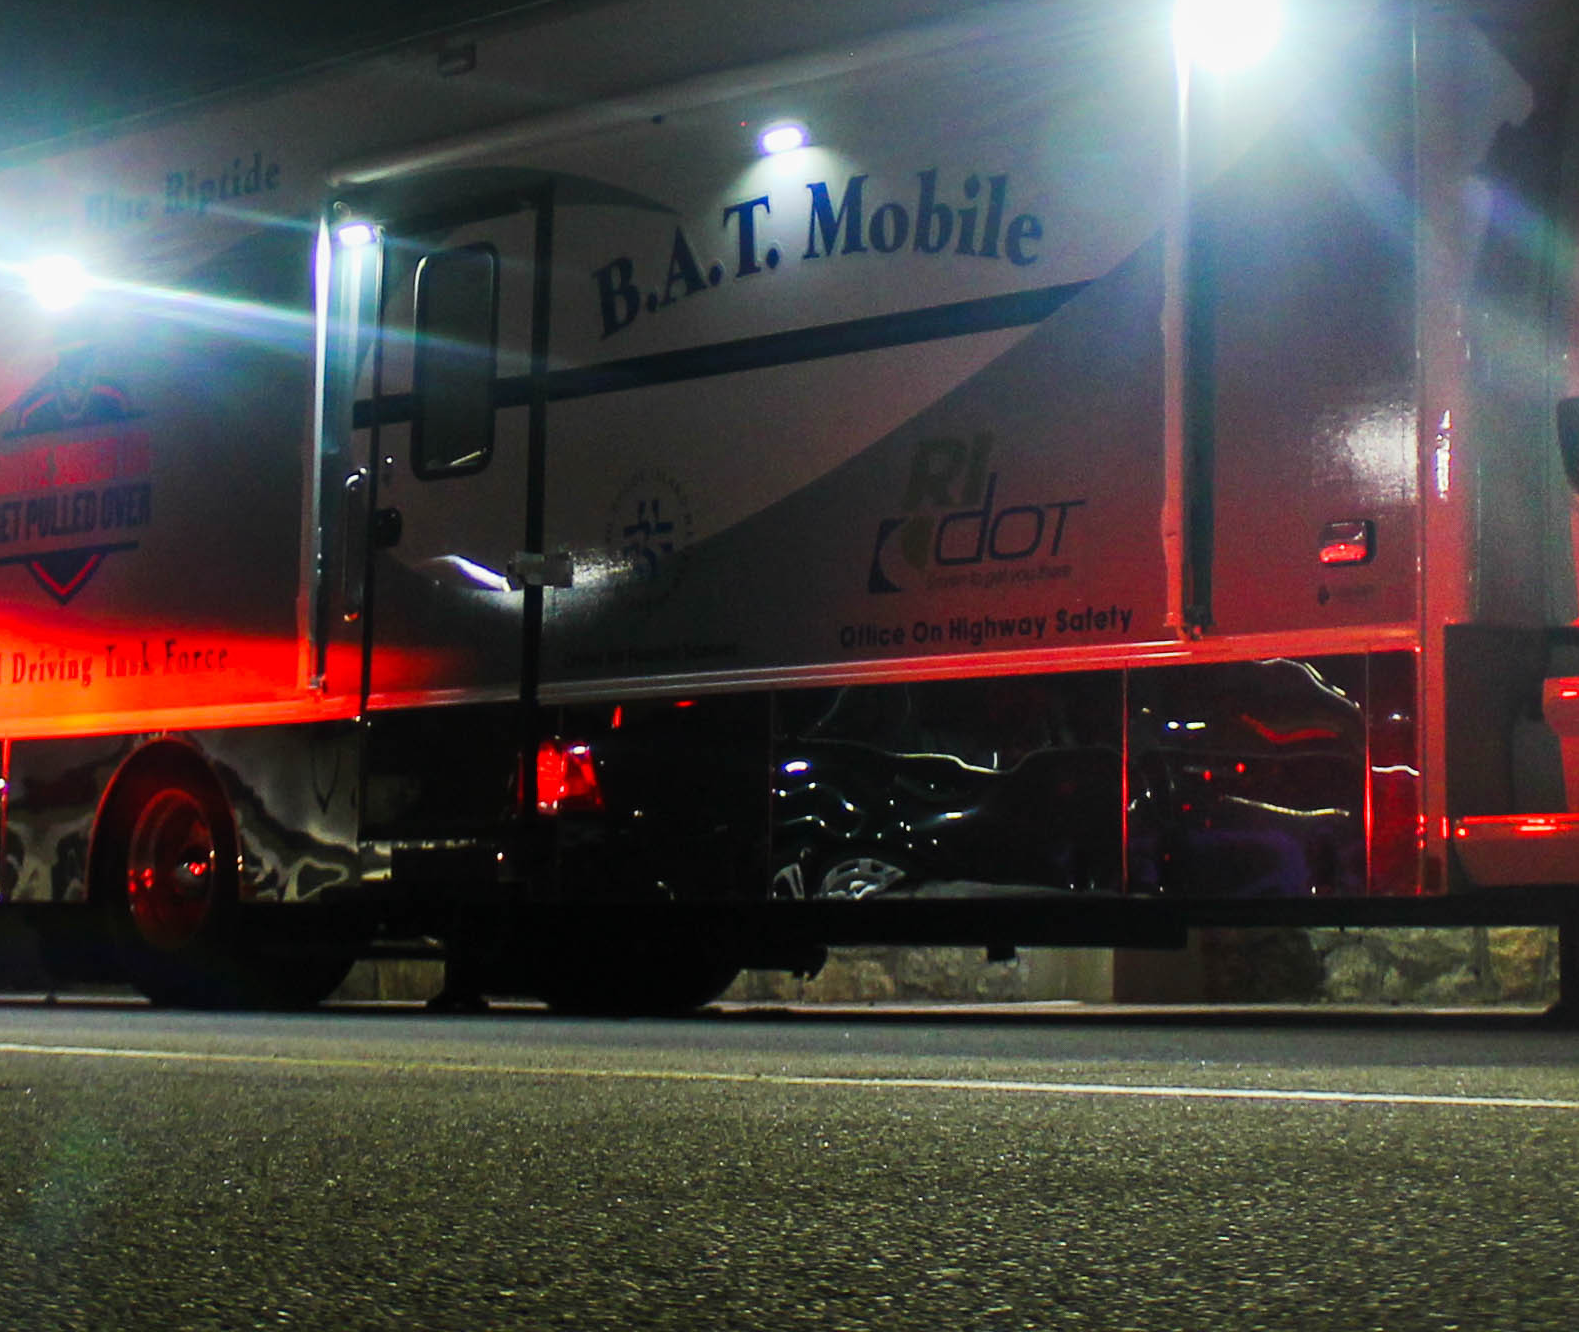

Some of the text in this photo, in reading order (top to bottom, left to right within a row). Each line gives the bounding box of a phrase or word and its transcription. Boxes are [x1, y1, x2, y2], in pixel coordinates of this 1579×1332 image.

[164, 151, 282, 217] Riptide
[591, 167, 1044, 339] B.A.T. Mobile
[25, 489, 98, 540] PULLED
[100, 482, 151, 530] OVER
[839, 604, 1133, 650] Office On Highway Safety
[12, 648, 92, 688] Driving
[163, 638, 228, 673] Force
